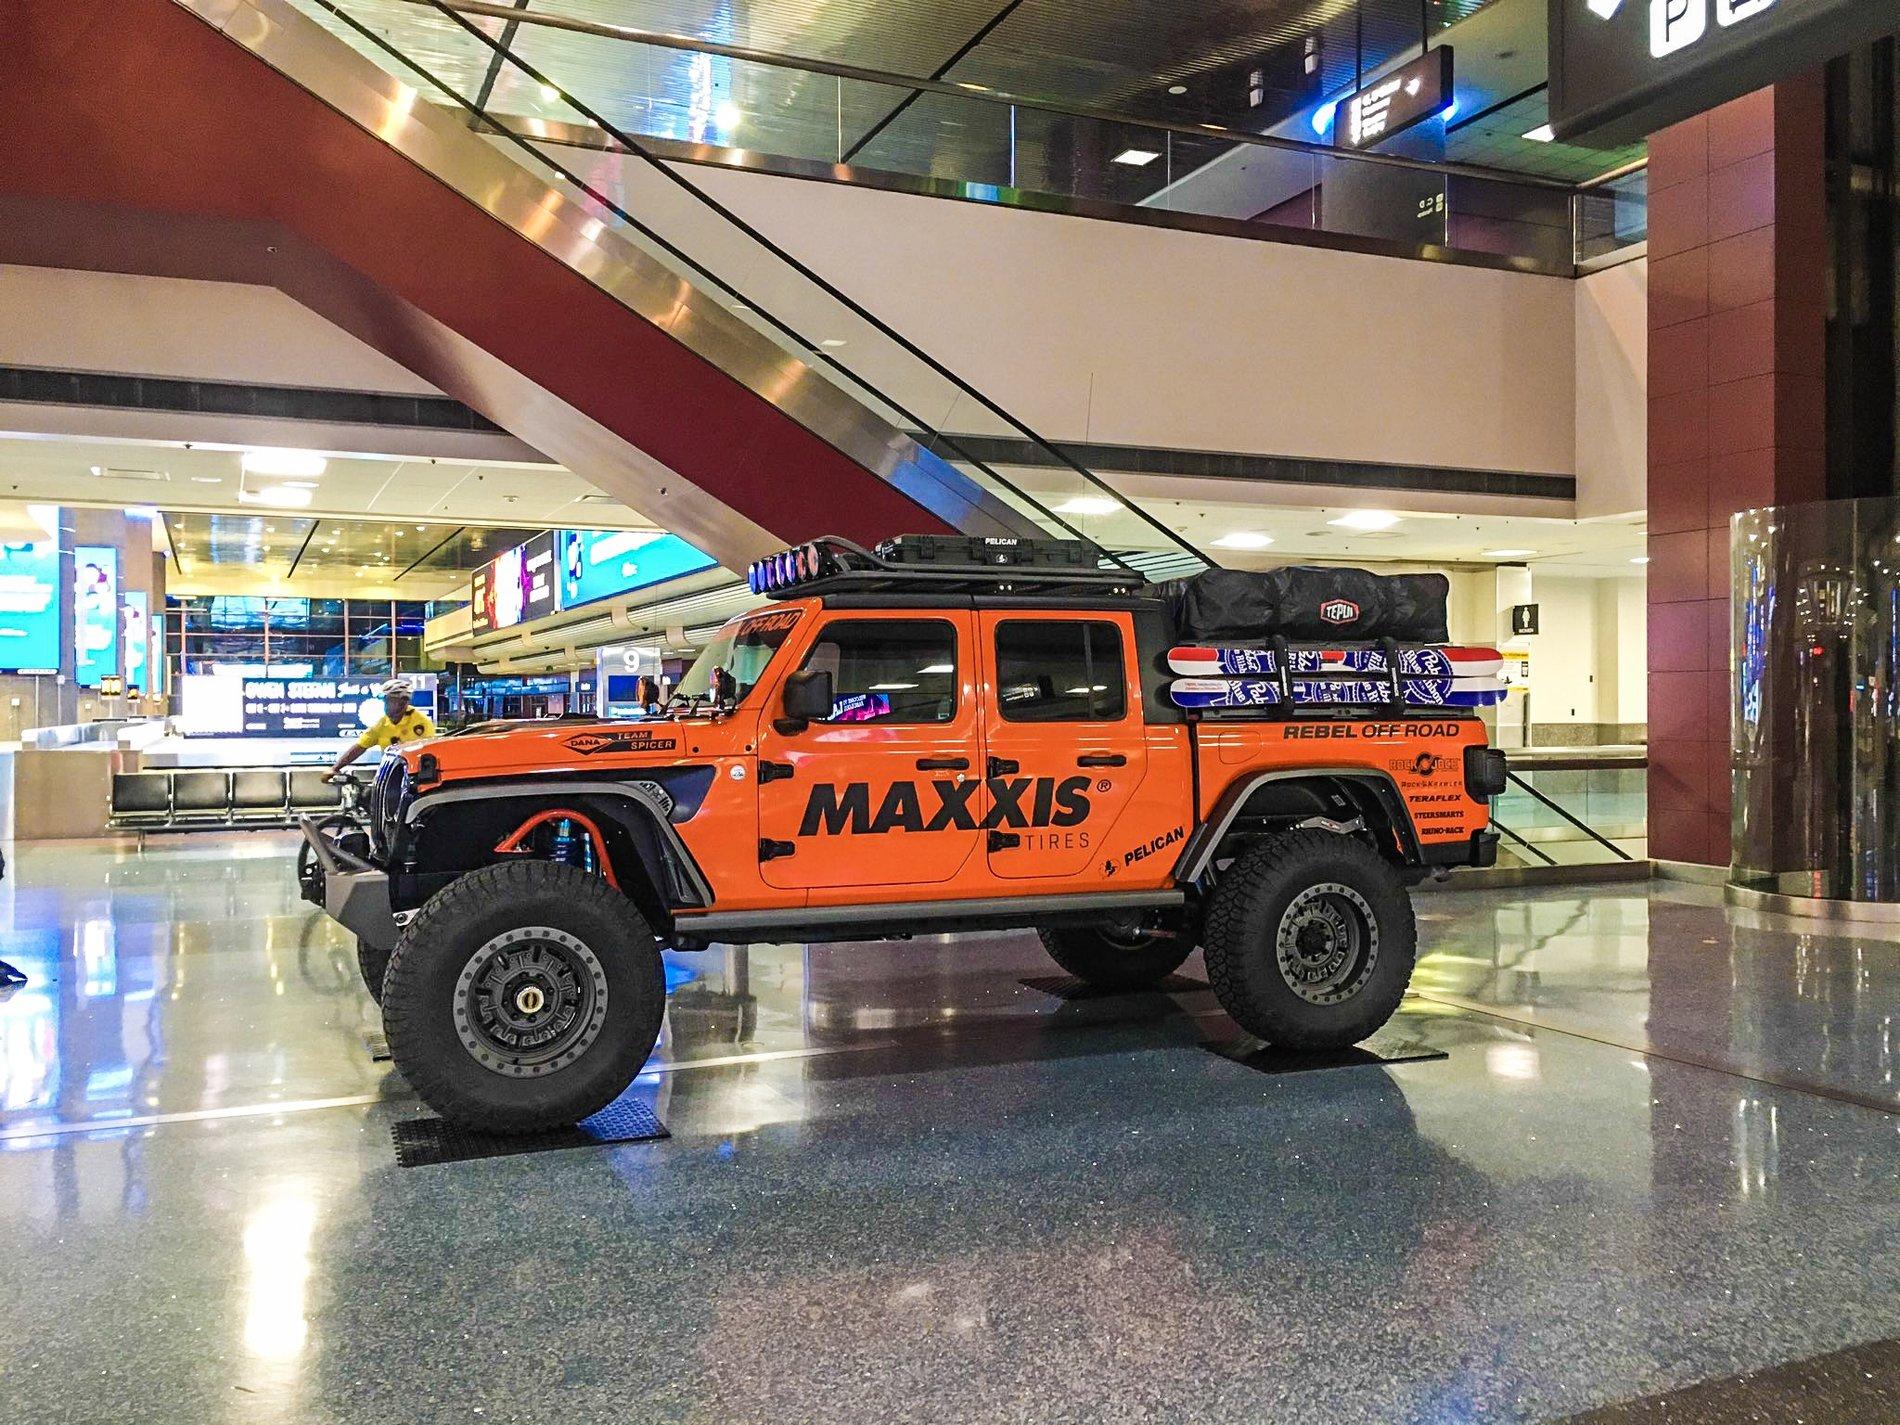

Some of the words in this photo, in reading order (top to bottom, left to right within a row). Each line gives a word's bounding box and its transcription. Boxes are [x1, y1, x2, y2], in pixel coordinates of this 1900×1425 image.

[984, 537, 1018, 545] PELICAN
[623, 649, 640, 674] 9
[1404, 650, 1422, 674] Blue
[618, 732, 648, 740] TEAM
[1283, 725, 1358, 739] REBEL
[1361, 724, 1402, 738] OFF
[1404, 723, 1460, 737] ROAD
[630, 740, 673, 750] SPICER
[798, 776, 1092, 836] MAXXIS
[1409, 794, 1462, 803] TERAFLEX
[1414, 810, 1465, 820] STEERSMARTS
[1025, 832, 1090, 851] TIRES
[1124, 825, 1185, 867] PELICAN
